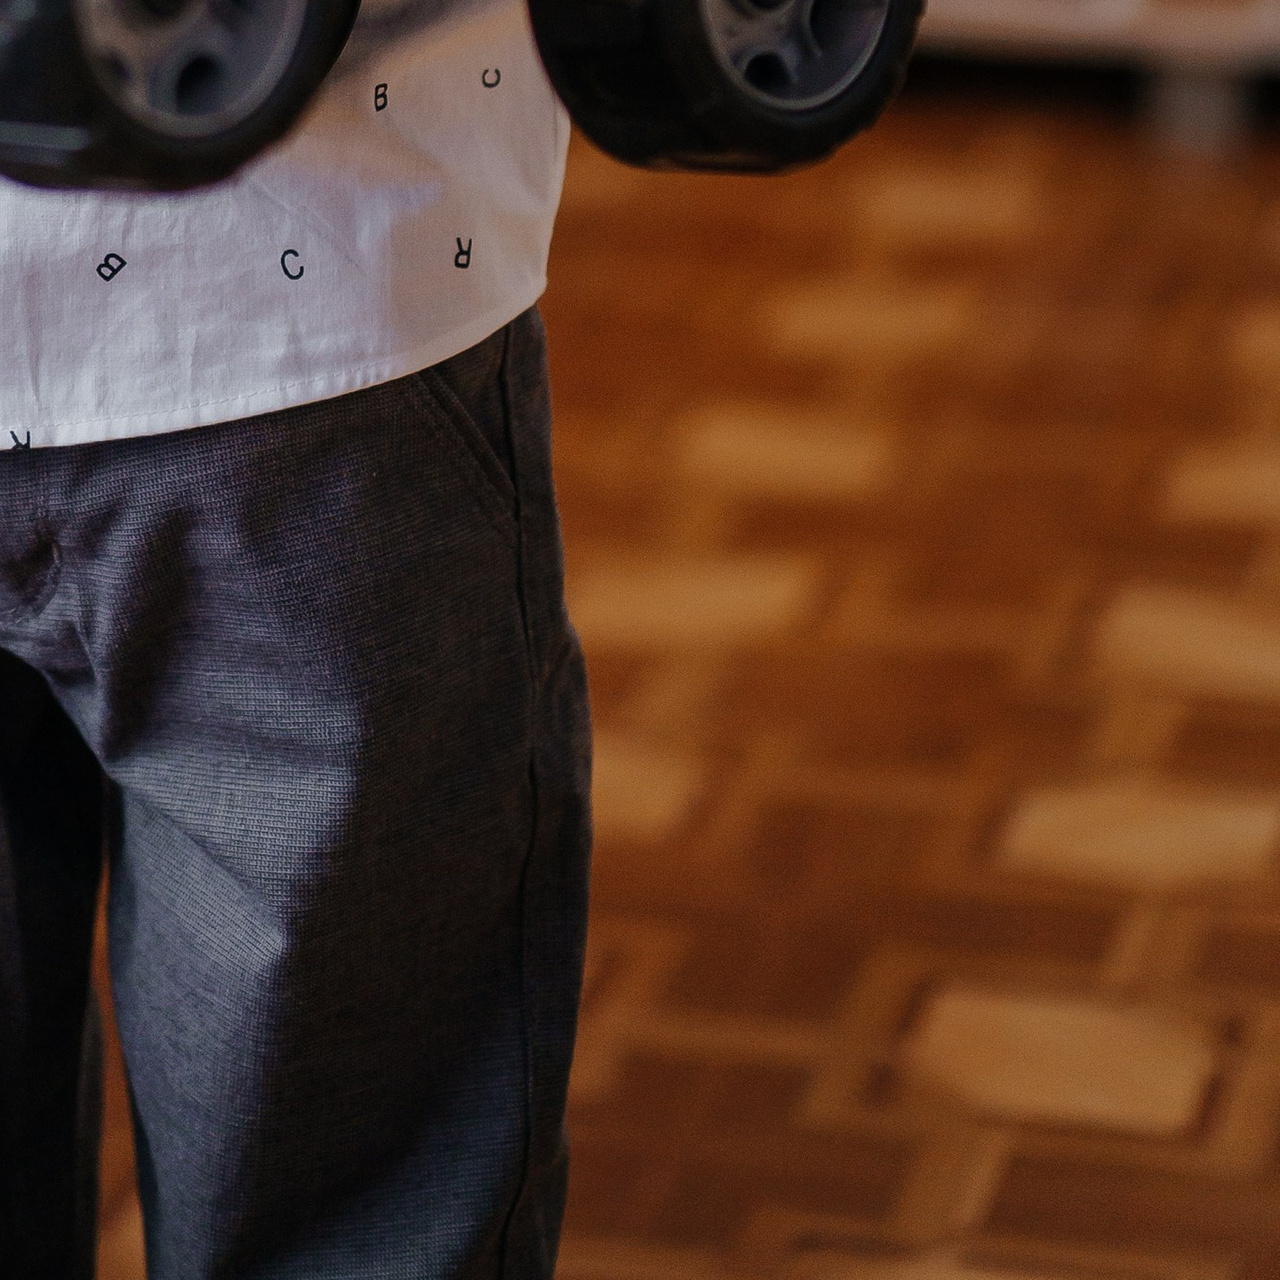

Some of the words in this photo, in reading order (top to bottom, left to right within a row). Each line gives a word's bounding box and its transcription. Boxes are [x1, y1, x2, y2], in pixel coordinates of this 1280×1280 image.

[481, 67, 501, 88] C
[373, 82, 388, 112] B
[95, 252, 127, 282] B
[280, 248, 304, 280] C
[453, 236, 473, 269] R
